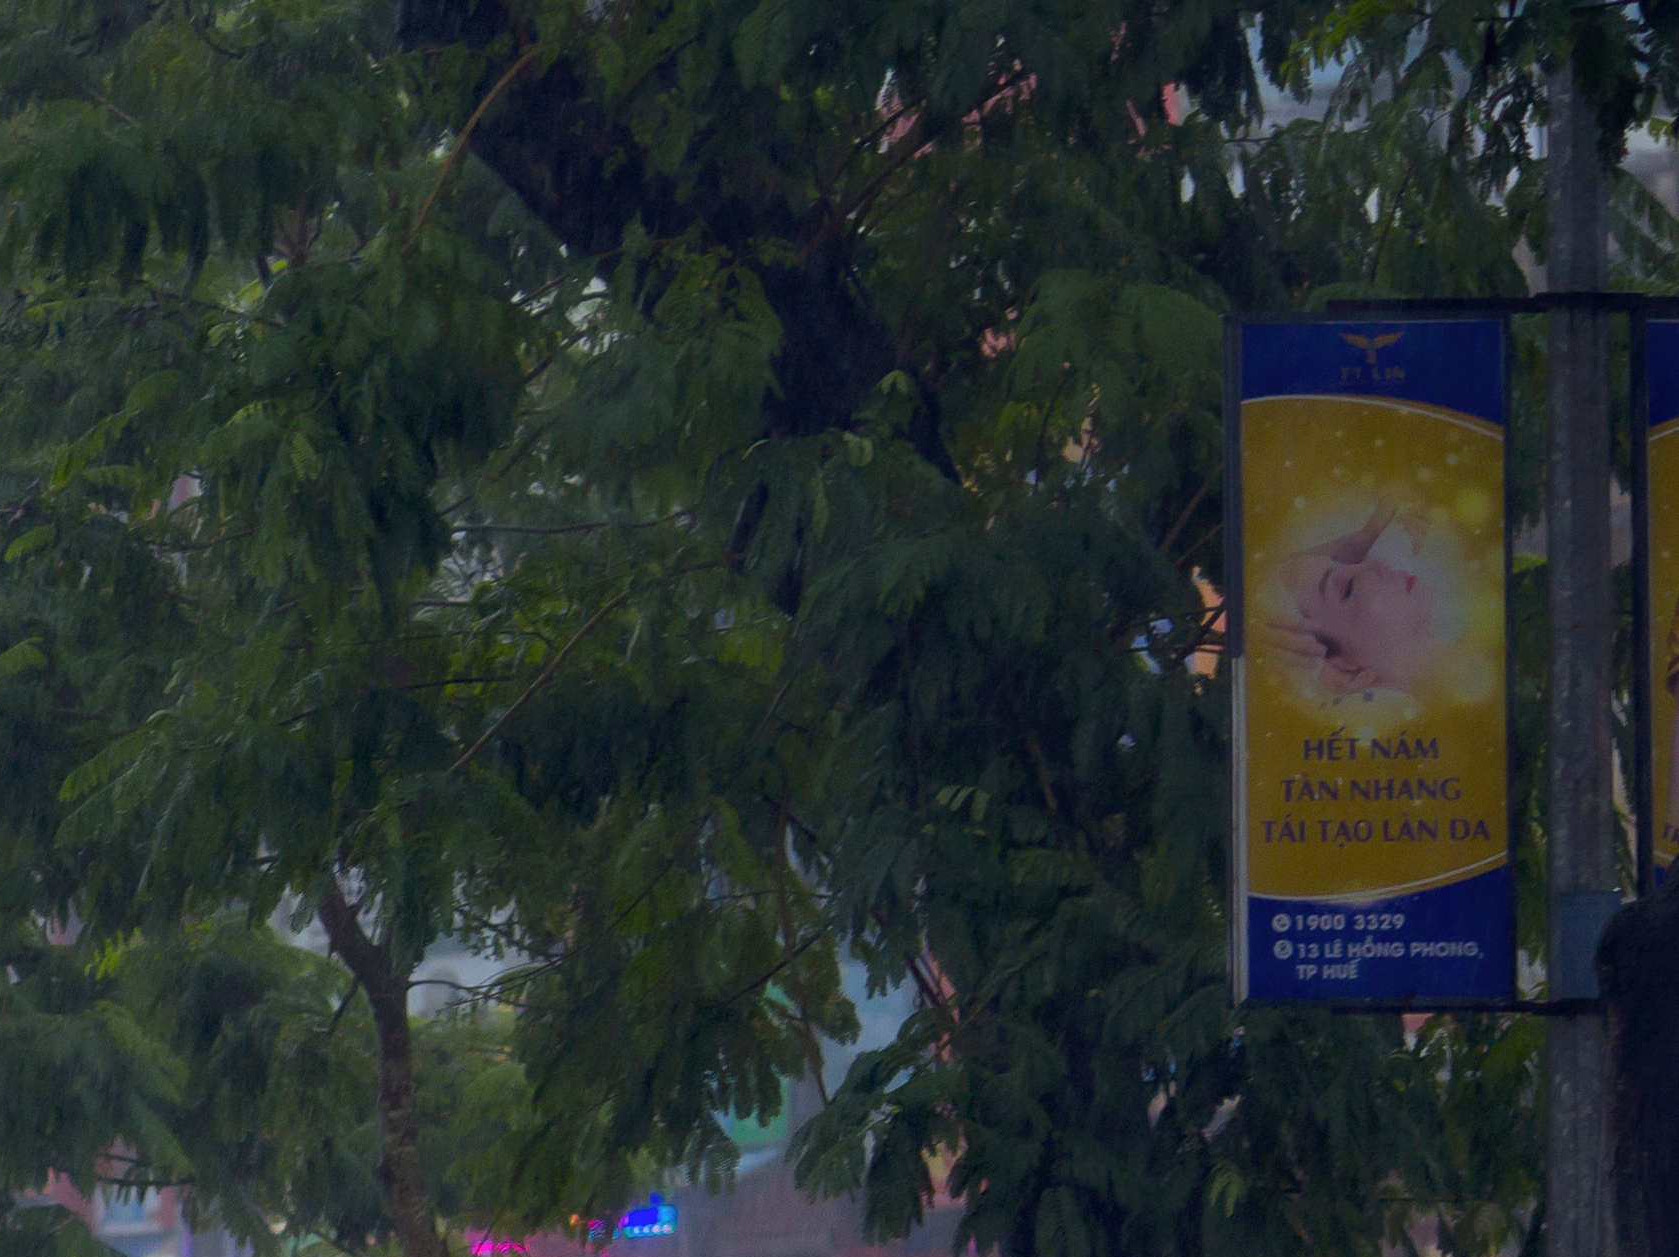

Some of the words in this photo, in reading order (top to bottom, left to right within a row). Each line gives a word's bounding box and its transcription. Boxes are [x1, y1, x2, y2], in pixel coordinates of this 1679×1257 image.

[1303, 726, 1359, 761] HẾT
[1370, 730, 1440, 760] NÁM
[1349, 776, 1462, 801] NHANG
[1261, 813, 1307, 843] TÁI
[1317, 819, 1374, 849] TẠO
[1449, 818, 1492, 842] DA
[1295, 914, 1346, 931] 1900
[1353, 913, 1406, 930] 3329
[1296, 943, 1320, 958] 13
[1296, 964, 1318, 979] TP
